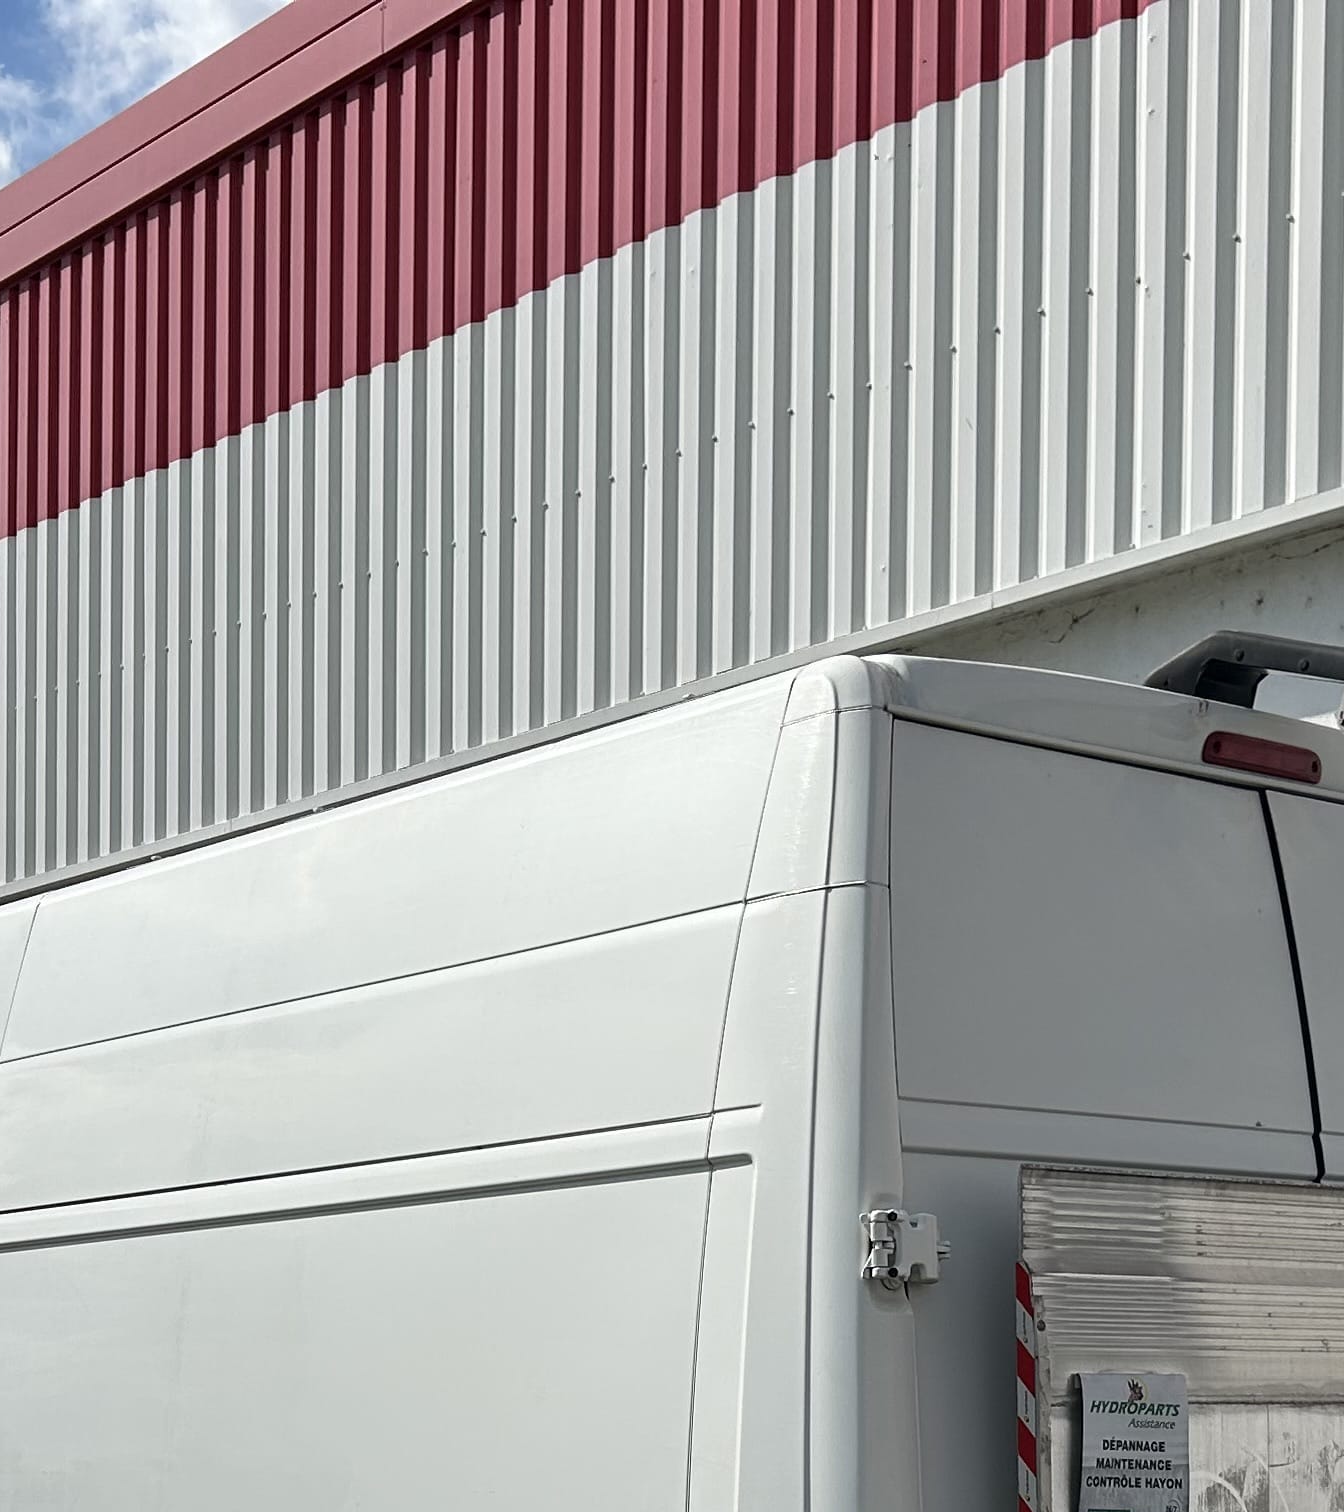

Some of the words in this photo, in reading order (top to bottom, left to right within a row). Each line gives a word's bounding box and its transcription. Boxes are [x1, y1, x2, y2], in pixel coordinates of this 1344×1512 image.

[1090, 1400, 1180, 1417] HYDROPARTS
[1128, 1418, 1176, 1430] Assistance
[1102, 1437, 1166, 1452] DÉPANNAGE
[1096, 1458, 1172, 1470] MAINTENANCE
[1086, 1475, 1141, 1488] CONTRÔLE
[1145, 1478, 1183, 1489] HAYON
